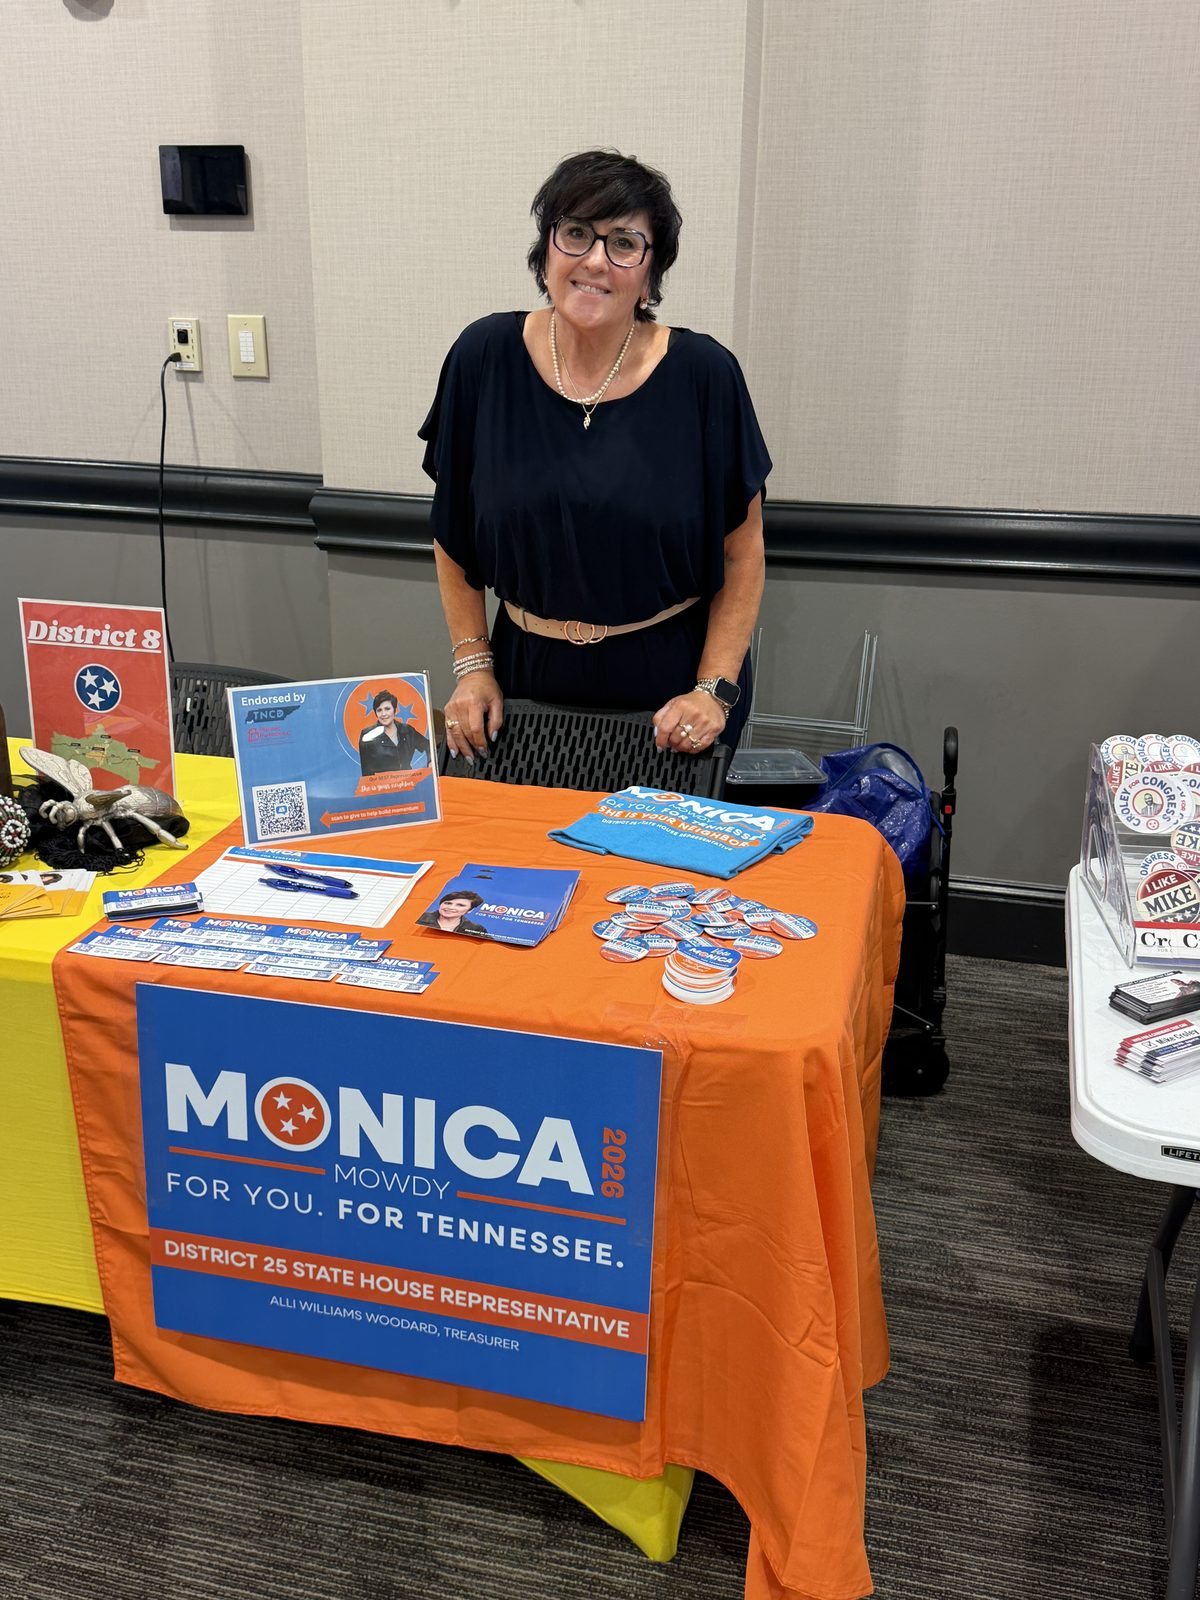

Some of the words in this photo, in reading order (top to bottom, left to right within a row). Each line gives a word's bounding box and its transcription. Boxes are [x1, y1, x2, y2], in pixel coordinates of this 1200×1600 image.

[27, 620, 137, 647] District
[141, 629, 161, 649] 8
[241, 693, 291, 706] Endorsed
[293, 692, 306, 703] by
[1154, 763, 1174, 771] LIKE
[1128, 780, 1140, 789] FOR
[1120, 788, 1141, 827] CROLEY
[1142, 776, 1177, 822] CONGRESS
[615, 786, 775, 831] MONICA
[628, 803, 656, 812] YOU.
[661, 808, 689, 820] FOR
[599, 805, 624, 817] SHE
[641, 812, 677, 825] YOUR
[678, 822, 750, 847] NEIGHBOR
[657, 824, 679, 836] HOUSE
[1140, 852, 1176, 876] ONGRESS
[118, 885, 185, 897] MONICA
[1145, 884, 1151, 893] I
[1152, 874, 1178, 891] LIKE
[1143, 884, 1197, 916] MIKE
[480, 903, 545, 920] MONICA
[205, 919, 267, 931] MONICA
[285, 927, 349, 940] MONICA
[738, 937, 778, 948] MONICA
[689, 948, 734, 963] MONICA
[710, 948, 731, 956] Vote
[1156, 1034, 1175, 1045] Mike
[1174, 1028, 1199, 1040] Croley
[165, 1062, 595, 1196] MONICA
[601, 1127, 627, 1199] 2026
[1169, 1148, 1200, 1160] LIFET
[335, 1163, 450, 1200] MOWDY
[167, 1172, 230, 1201] FOR
[243, 1183, 323, 1216] YOU.
[338, 1198, 404, 1230] FOR
[417, 1211, 624, 1268] TENNESSEE.
[164, 1239, 258, 1269] DISTRICT
[263, 1256, 288, 1275] 25
[293, 1260, 354, 1287] STATE
[360, 1272, 435, 1301] HOUSE
[440, 1286, 630, 1338] REPRESENTATIVE
[270, 1295, 296, 1309] ALLI
[300, 1300, 362, 1321] WILLIAMS
[366, 1312, 440, 1337] WOODARD,
[443, 1326, 520, 1352] TREASURER
